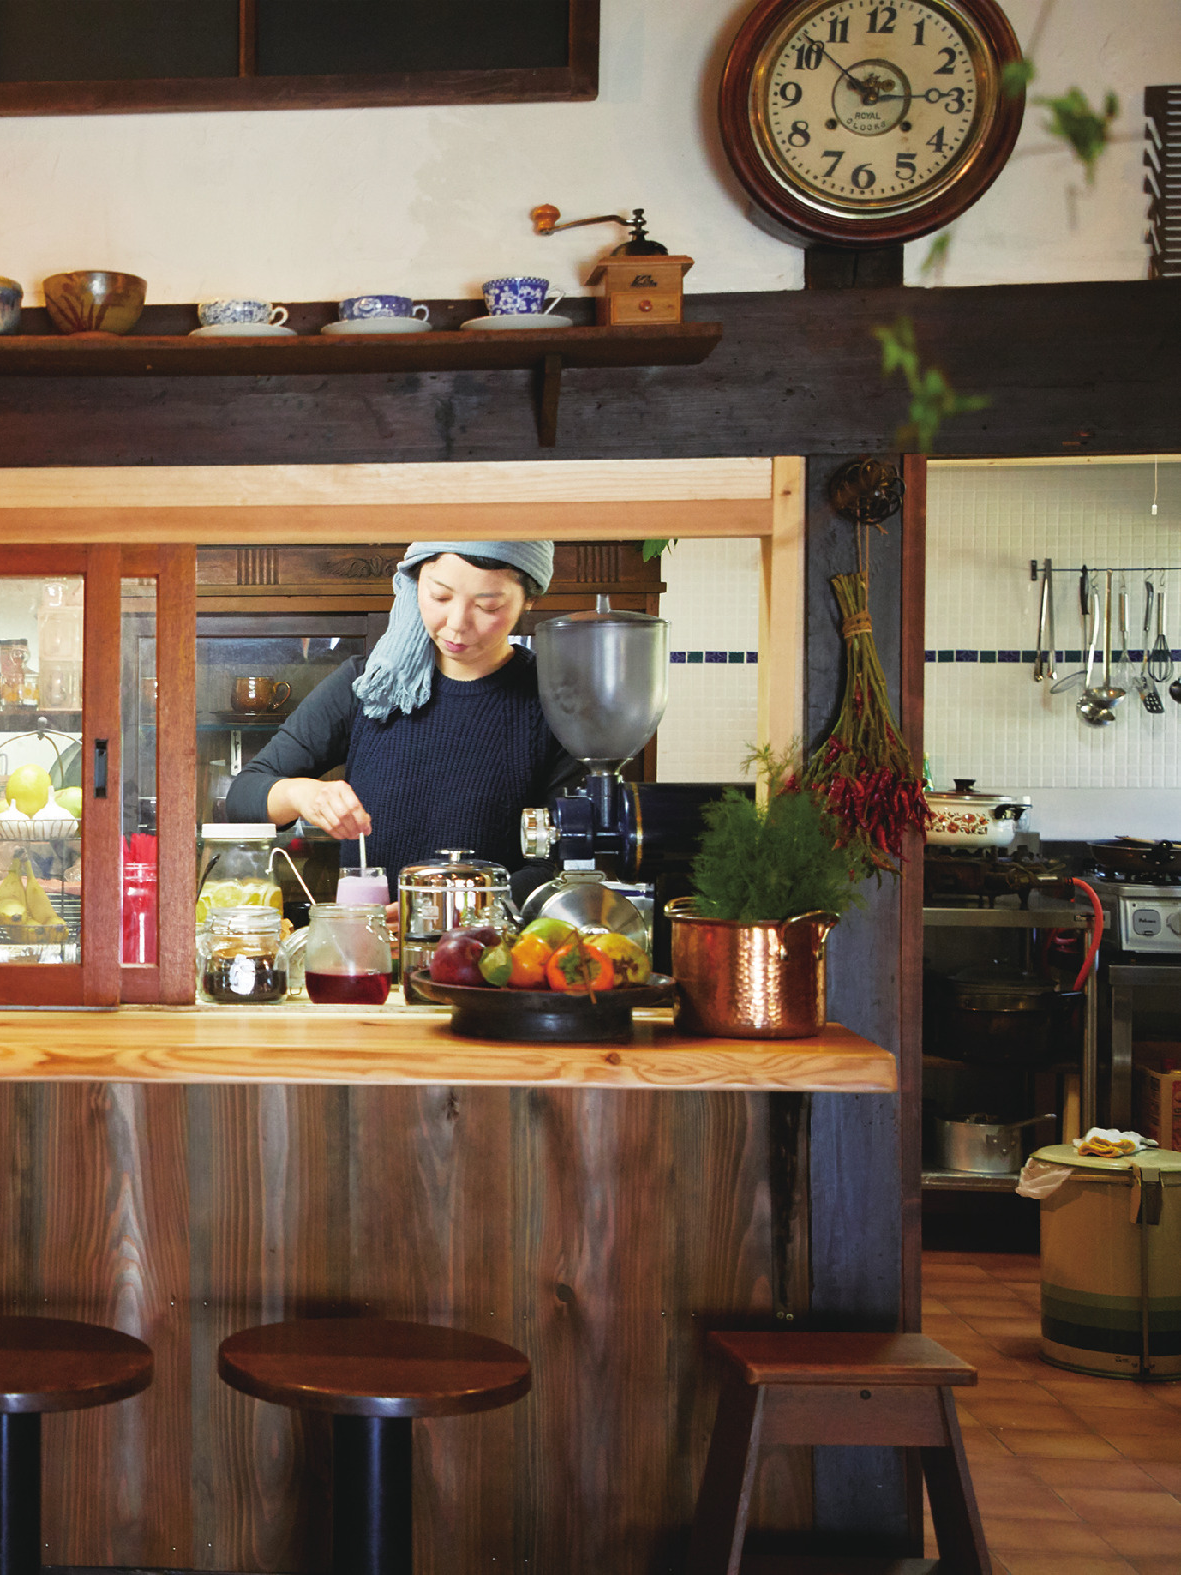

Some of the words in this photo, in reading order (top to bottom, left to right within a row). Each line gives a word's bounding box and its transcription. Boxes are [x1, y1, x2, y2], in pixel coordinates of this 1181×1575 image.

[826, 16, 849, 43] 11
[867, 7, 897, 33] 12
[913, 19, 925, 45] 1
[794, 42, 823, 70] 10
[934, 47, 957, 74] 2
[779, 82, 802, 108] 9
[945, 87, 965, 114] 3
[855, 112, 881, 120] ROYAL
[788, 121, 810, 147] 8
[927, 127, 948, 152] 4
[821, 151, 845, 177] 7
[851, 164, 875, 189] 6
[896, 153, 917, 180] 5
